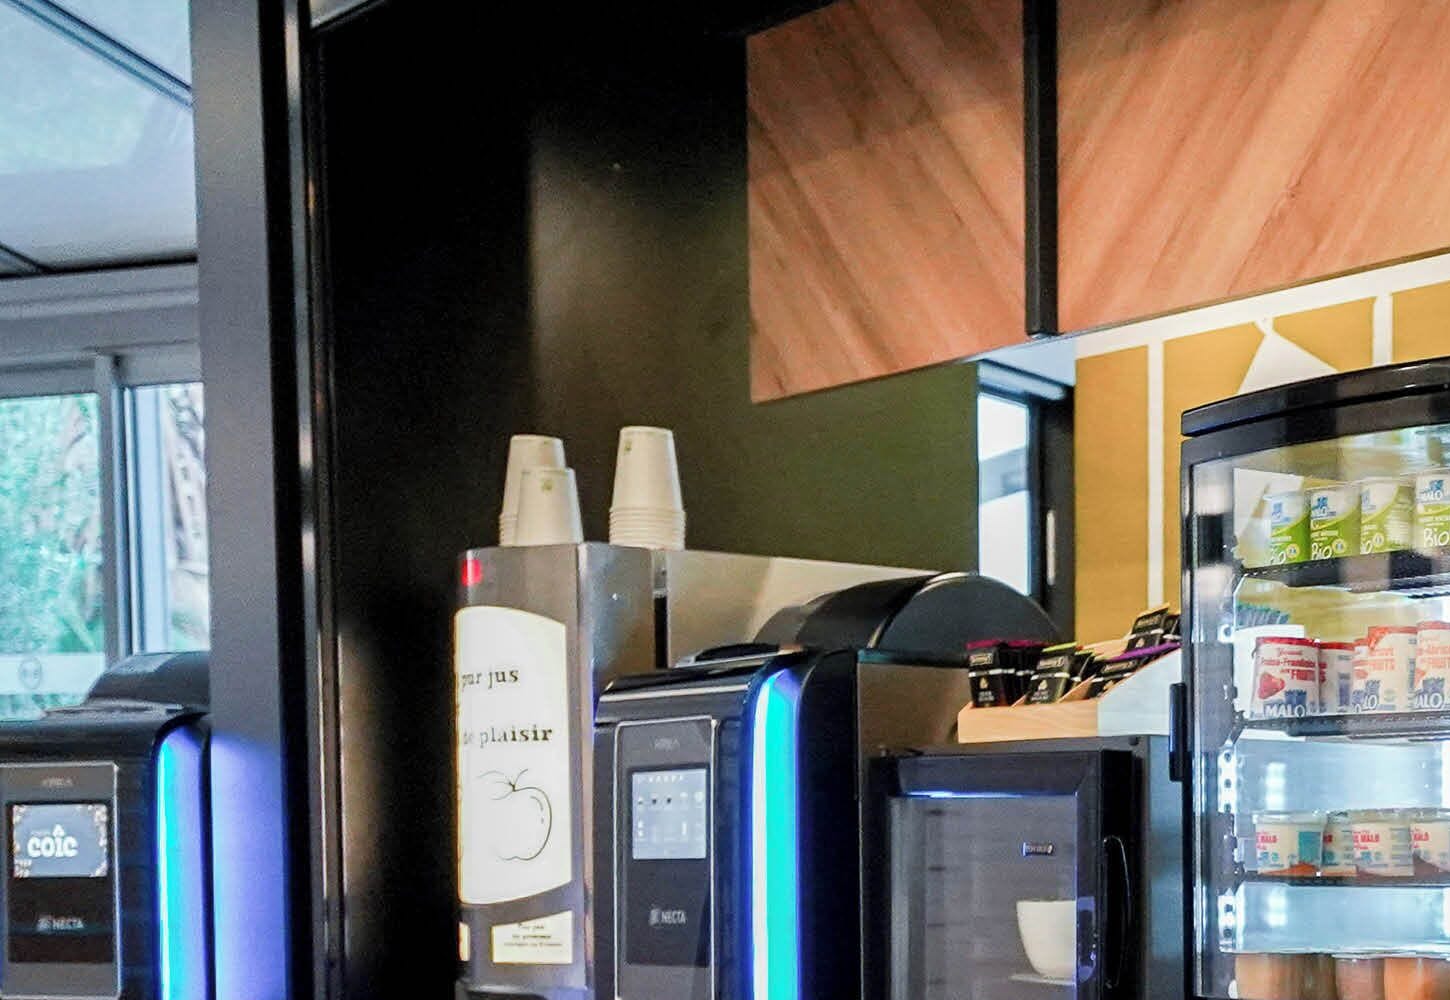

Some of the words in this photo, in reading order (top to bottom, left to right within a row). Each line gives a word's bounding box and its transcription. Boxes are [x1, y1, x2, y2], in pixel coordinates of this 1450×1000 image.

[1423, 525, 1450, 548] Bio
[488, 665, 519, 690] jus
[480, 724, 553, 749] plaisir
[53, 917, 84, 930] NECTA
[661, 910, 687, 924] NECTA
